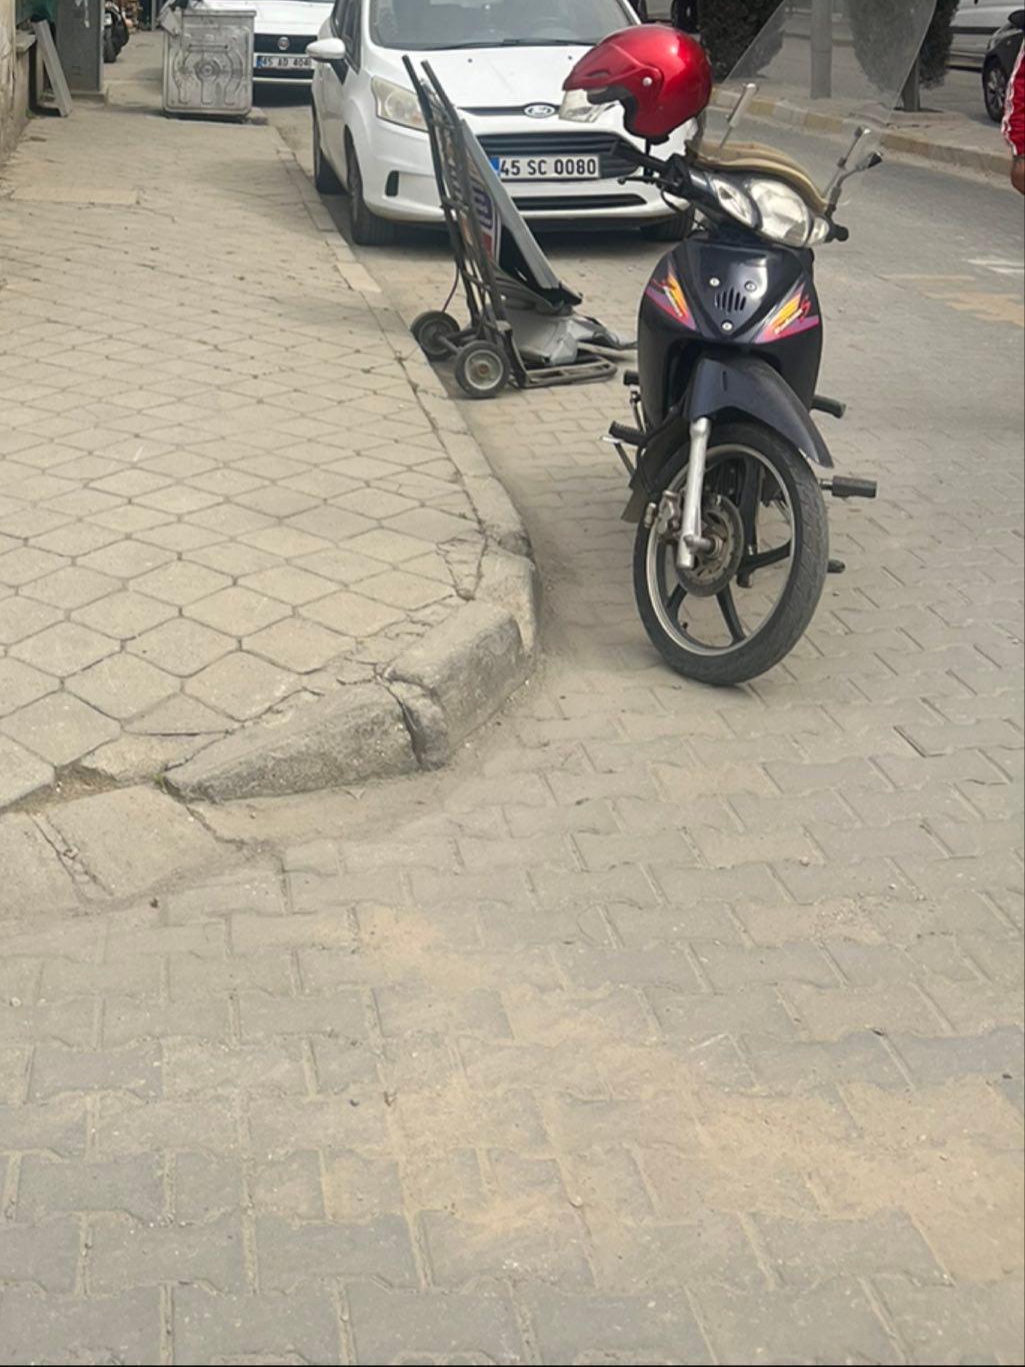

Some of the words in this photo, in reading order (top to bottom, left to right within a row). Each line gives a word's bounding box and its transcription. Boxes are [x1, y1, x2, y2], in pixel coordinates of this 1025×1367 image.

[500, 160, 521, 176] 45
[527, 159, 547, 176] SC
[554, 159, 596, 175] 0080
